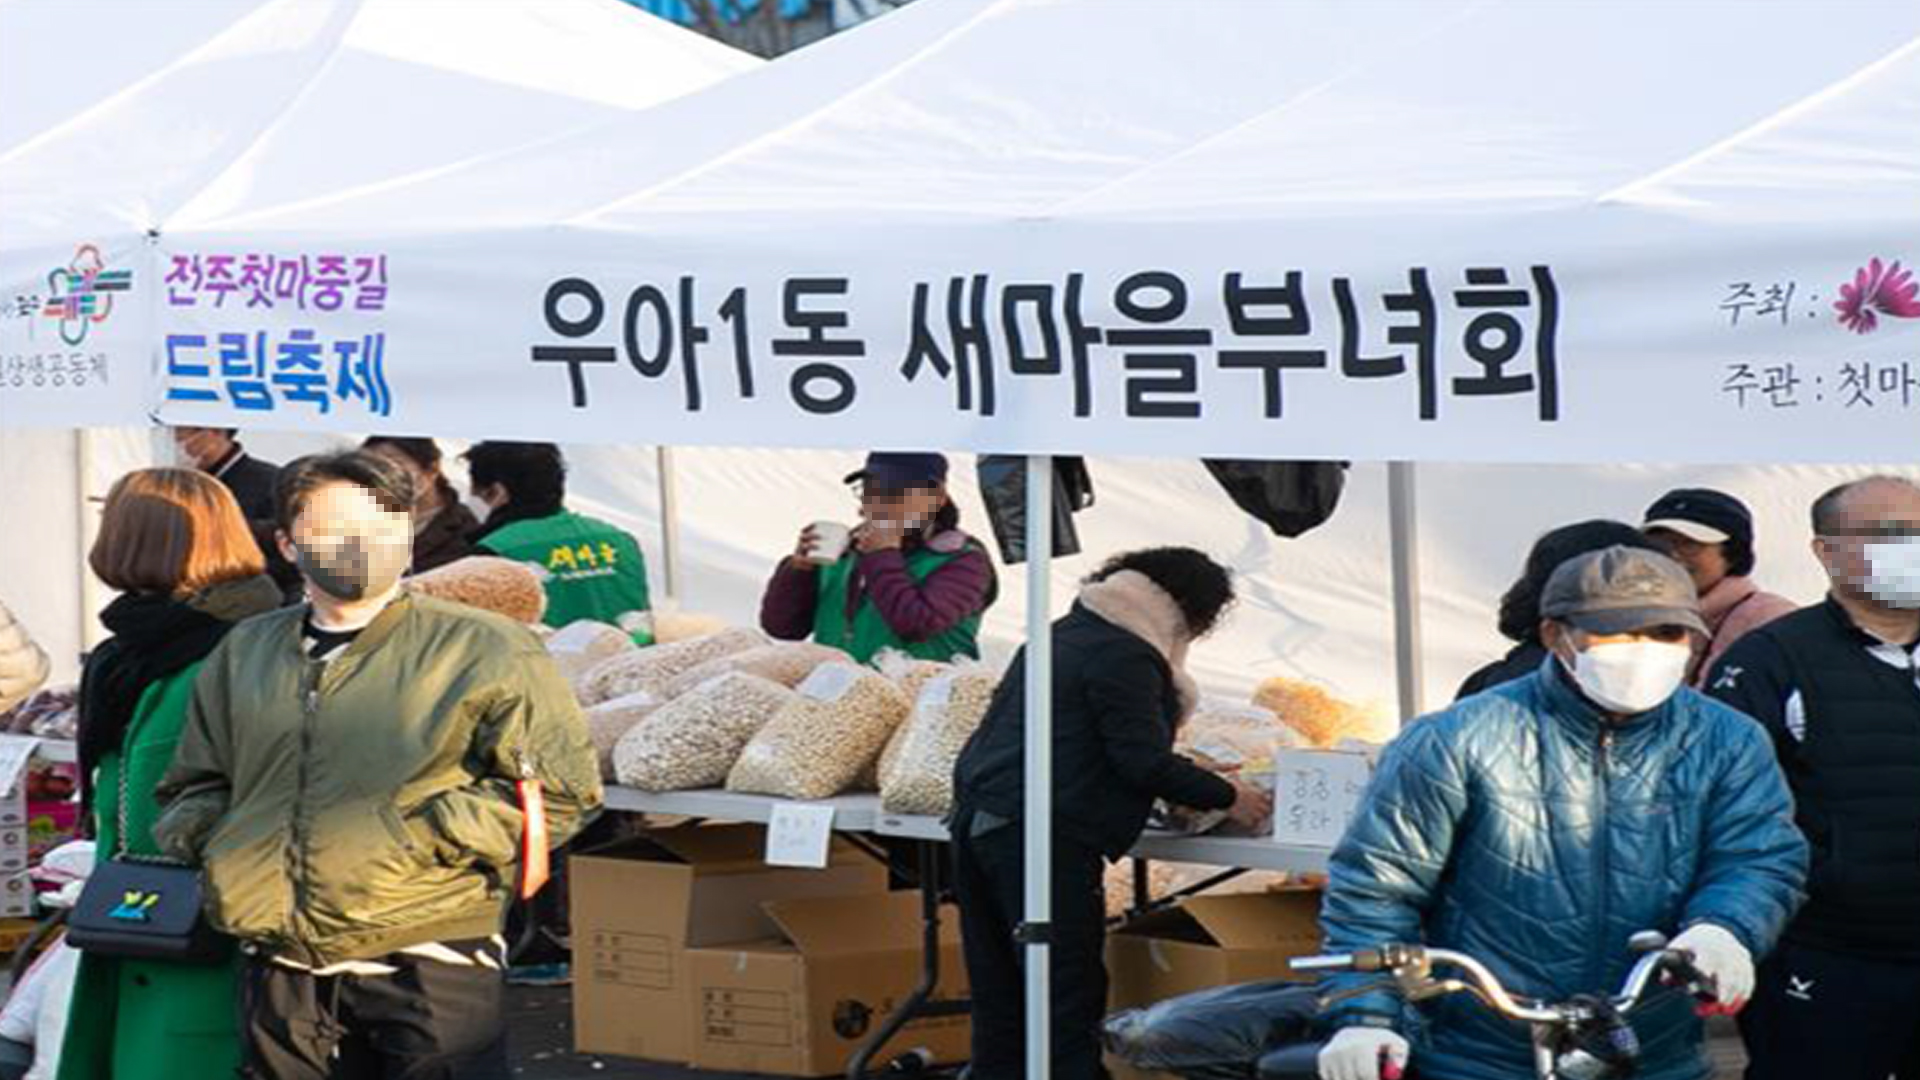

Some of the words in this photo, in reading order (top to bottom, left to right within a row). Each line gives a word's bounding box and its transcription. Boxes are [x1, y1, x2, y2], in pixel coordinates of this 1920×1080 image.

[164, 254, 388, 312] 전주첫마중길
[1719, 281, 1796, 325] 주최
[531, 276, 866, 415] 우아1동
[900, 265, 1559, 422] 새마을부녀회
[165, 329, 392, 418] 드림축제
[1722, 363, 1801, 408] 주관
[1838, 362, 1920, 408] 첫마
